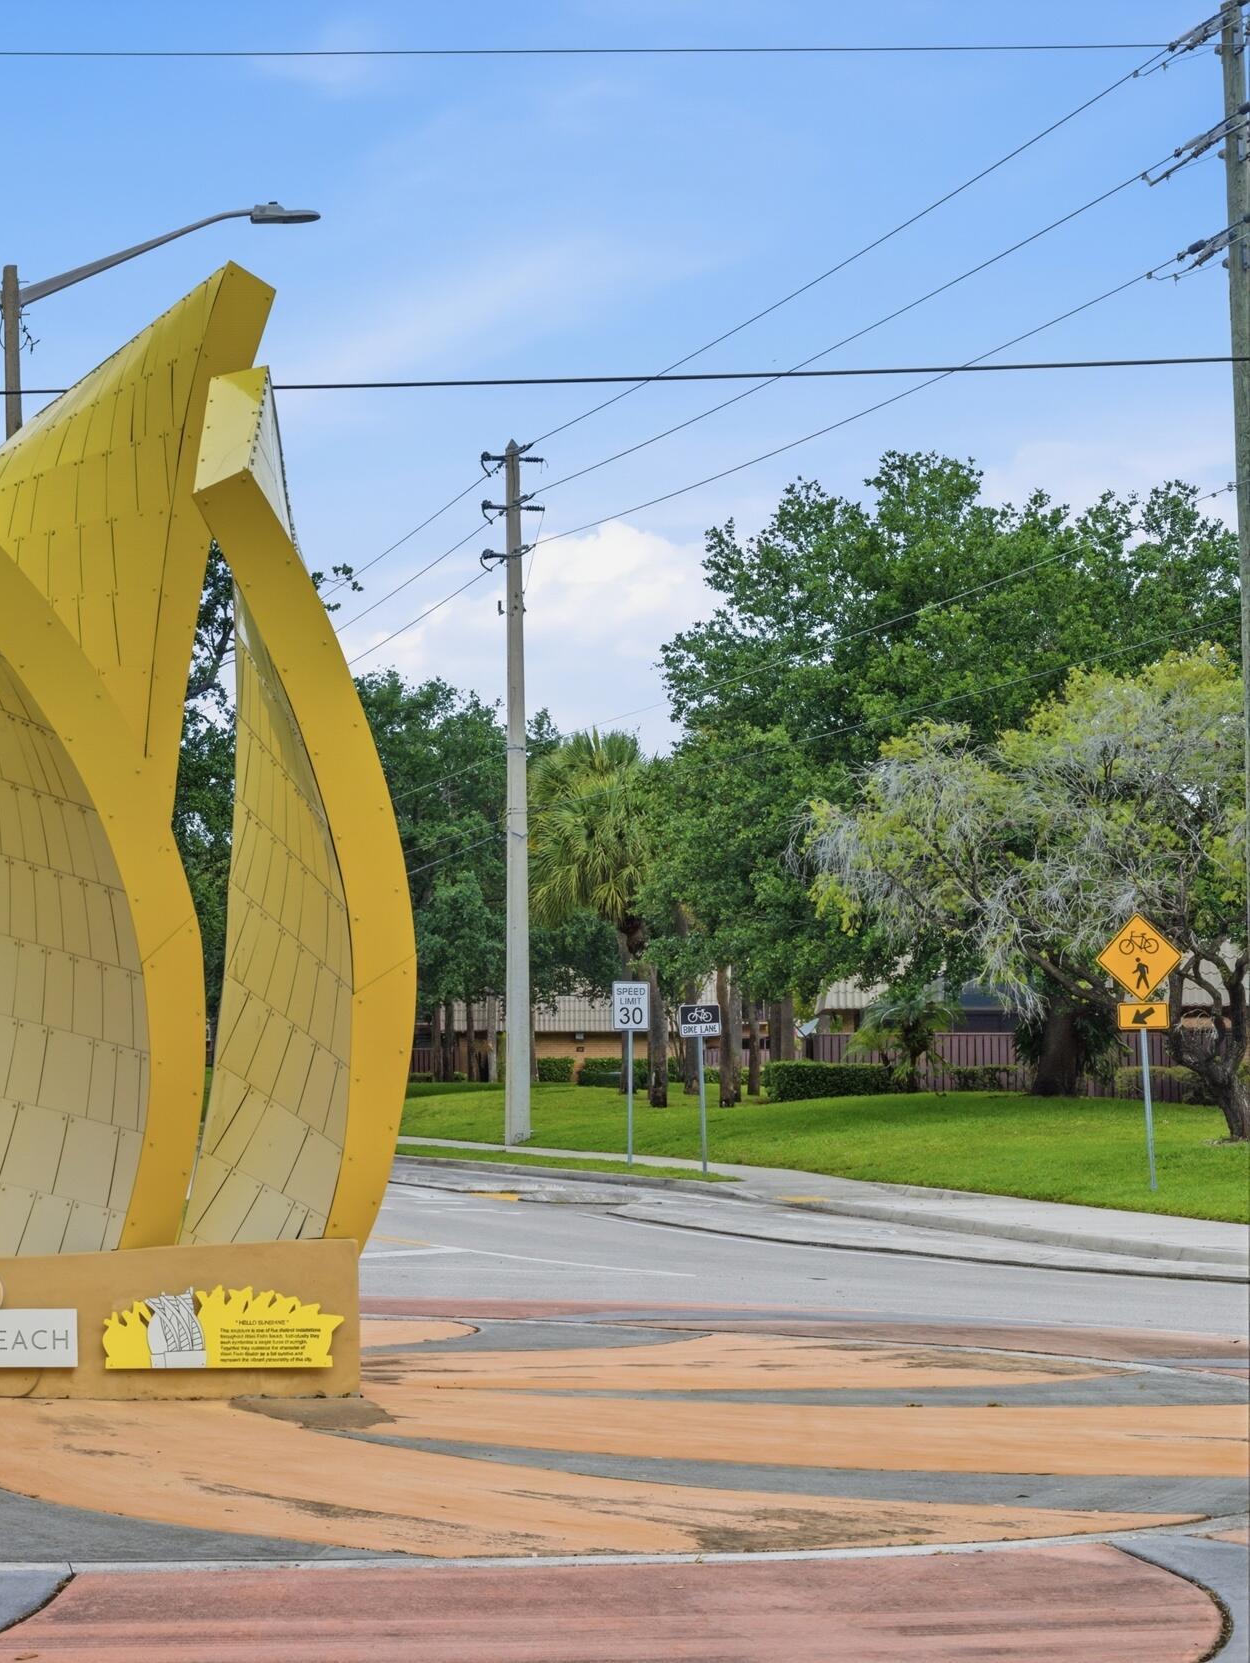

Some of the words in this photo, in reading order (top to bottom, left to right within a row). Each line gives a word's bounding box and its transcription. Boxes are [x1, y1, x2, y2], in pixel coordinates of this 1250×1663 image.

[616, 987, 645, 996] SPEED
[619, 997, 642, 1005] LIMIT
[619, 1007, 643, 1025] 30
[683, 1025, 698, 1034] BIKE
[700, 1024, 718, 1033] LANE
